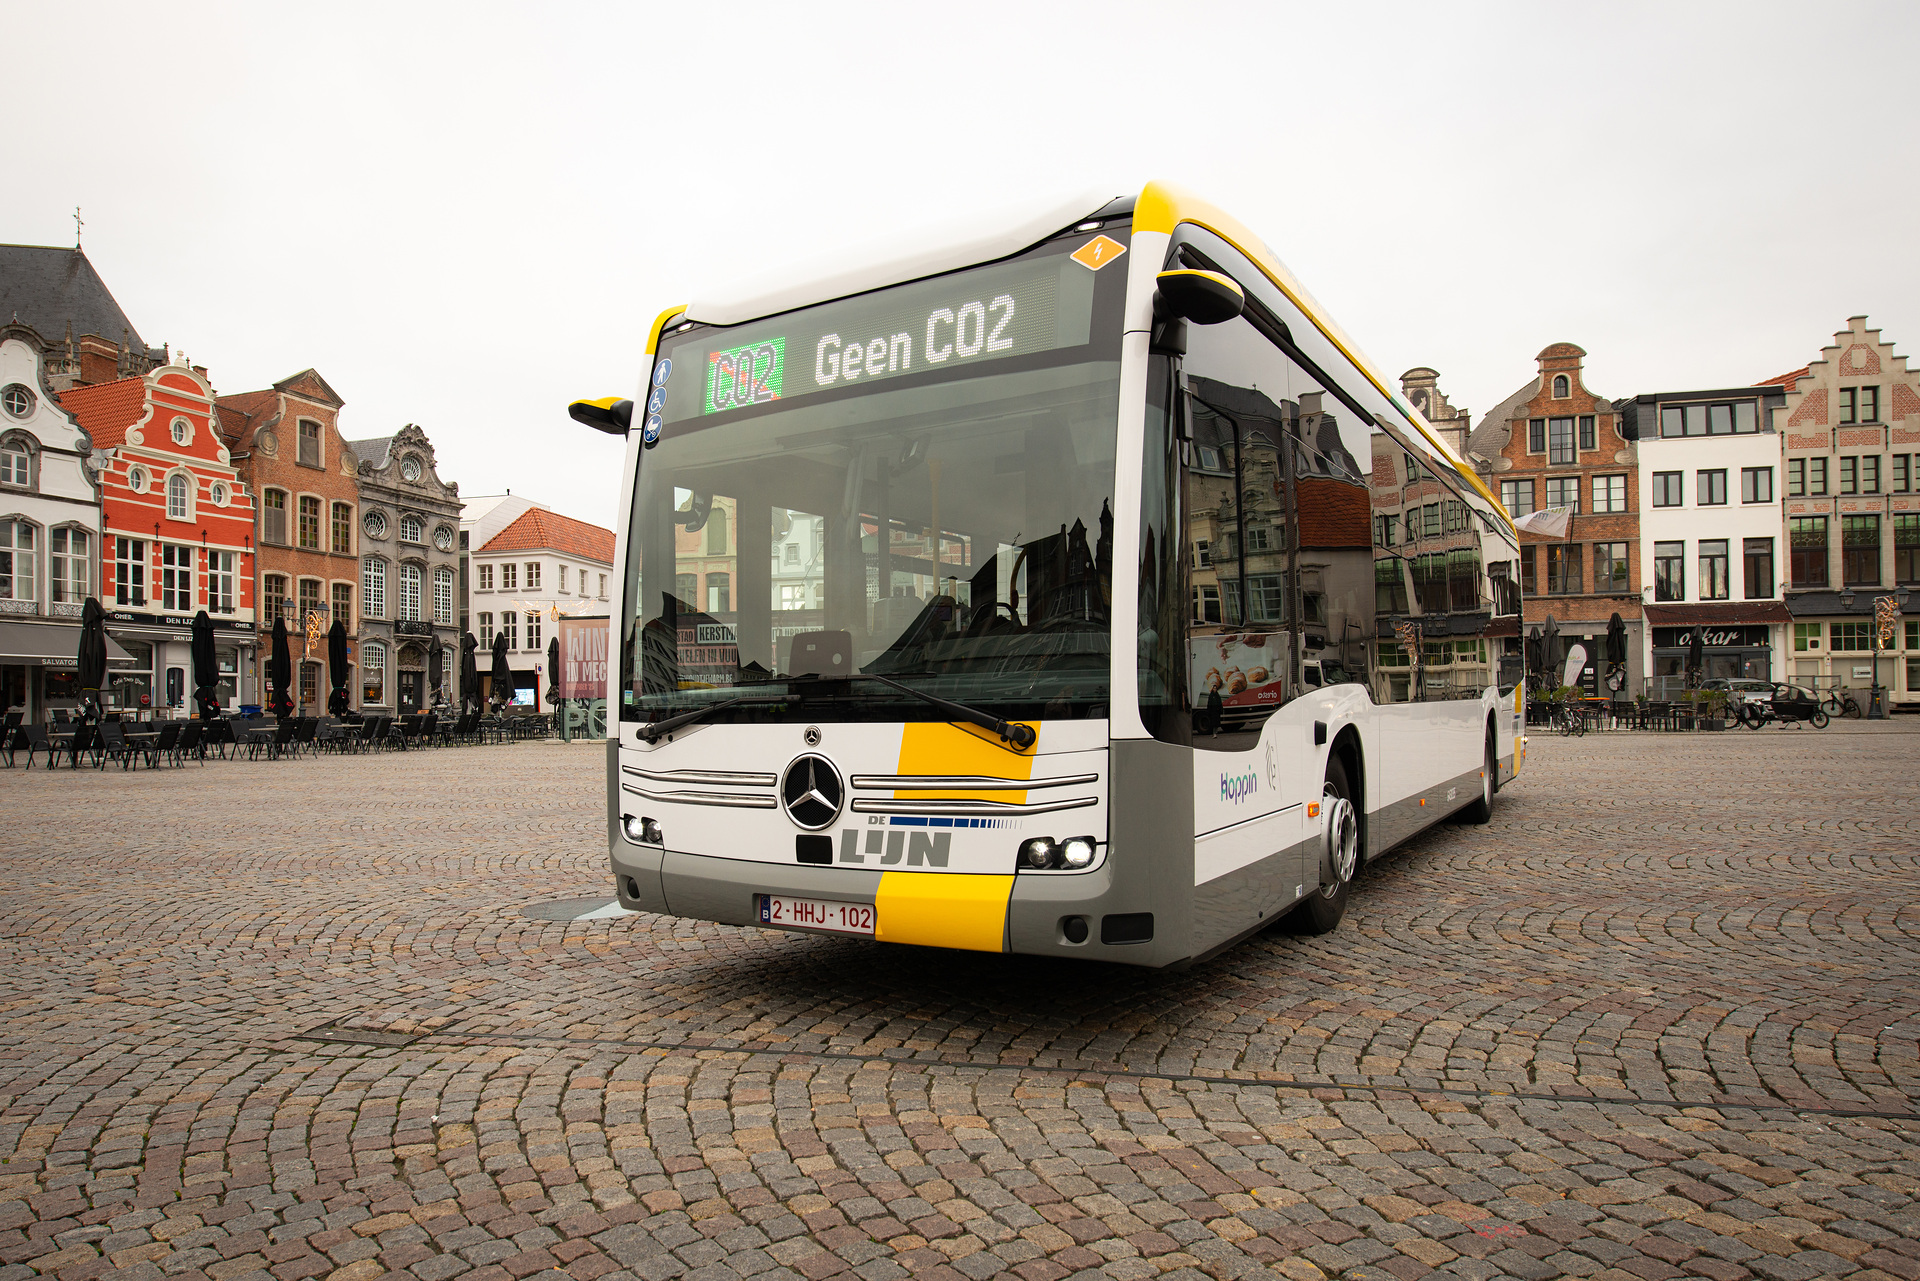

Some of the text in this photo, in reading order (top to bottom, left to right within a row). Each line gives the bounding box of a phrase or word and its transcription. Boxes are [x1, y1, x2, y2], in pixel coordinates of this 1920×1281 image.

[814, 294, 1015, 386] Geen CO2
[710, 343, 778, 412] CO2
[166, 617, 181, 625] DEN
[566, 627, 609, 661] WIN
[1679, 627, 1740, 646] okar
[41, 658, 78, 666] SALVATOR
[566, 661, 578, 682] IN
[1221, 764, 1257, 805] Hoppin
[868, 816, 886, 825] DE
[839, 829, 952, 868] LIJN
[762, 909, 770, 920] B
[772, 900, 871, 929] 2-HHJ-102
